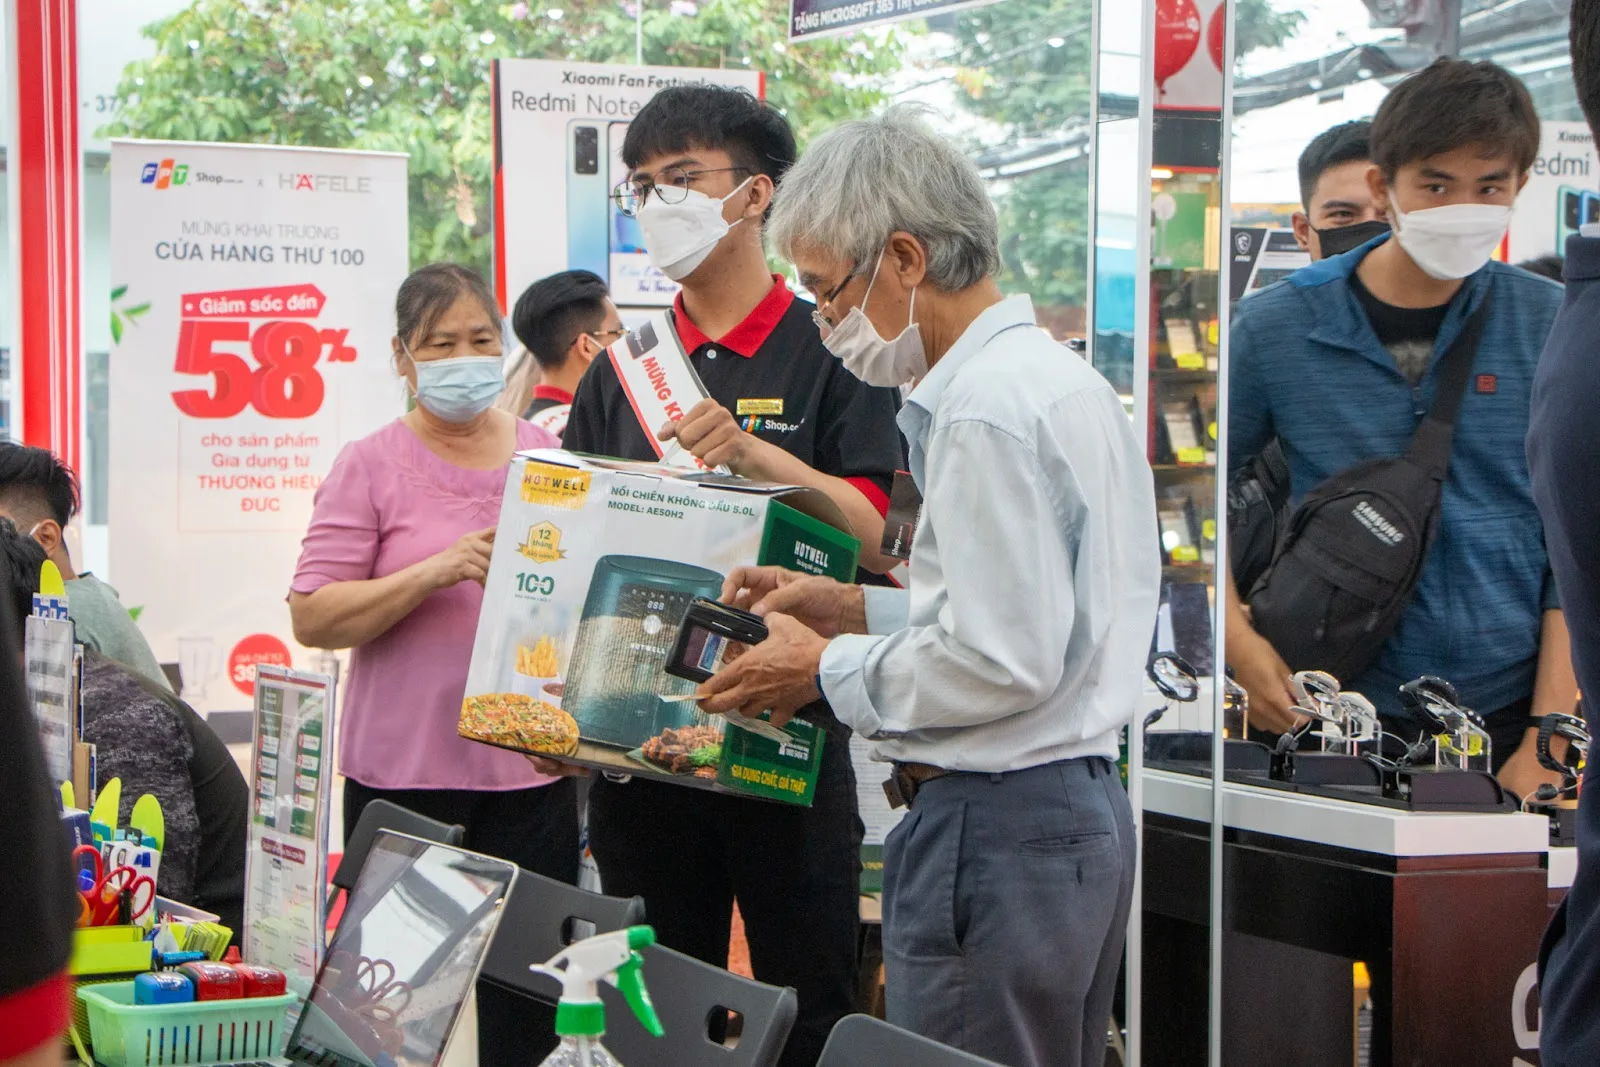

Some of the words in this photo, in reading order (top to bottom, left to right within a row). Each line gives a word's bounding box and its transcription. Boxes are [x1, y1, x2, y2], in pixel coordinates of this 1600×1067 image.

[820, 1, 873, 26] MICROSOFT
[562, 71, 616, 86] Xiaomi
[618, 74, 645, 88] Fan
[511, 90, 576, 113] Redmi
[587, 94, 640, 116] Note
[1533, 151, 1590, 176] edmi
[141, 158, 189, 190] FPT
[278, 172, 373, 194] HÄFELE
[330, 248, 365, 266] 100
[641, 356, 673, 402] MỪNG
[741, 414, 763, 433] FPT
[201, 432, 232, 448] cho
[211, 452, 240, 468] Gia
[523, 474, 586, 492] HOTWELL
[608, 501, 644, 514] MODEL:
[646, 506, 684, 520] AE50H2
[632, 490, 666, 503] CHIÊN
[667, 493, 706, 509] KHÔNG
[733, 505, 755, 517] 5.0L
[1355, 501, 1405, 543] SAMSUNG
[538, 529, 552, 540] 12
[794, 540, 829, 568] HOTWELL
[515, 572, 555, 596] 100
